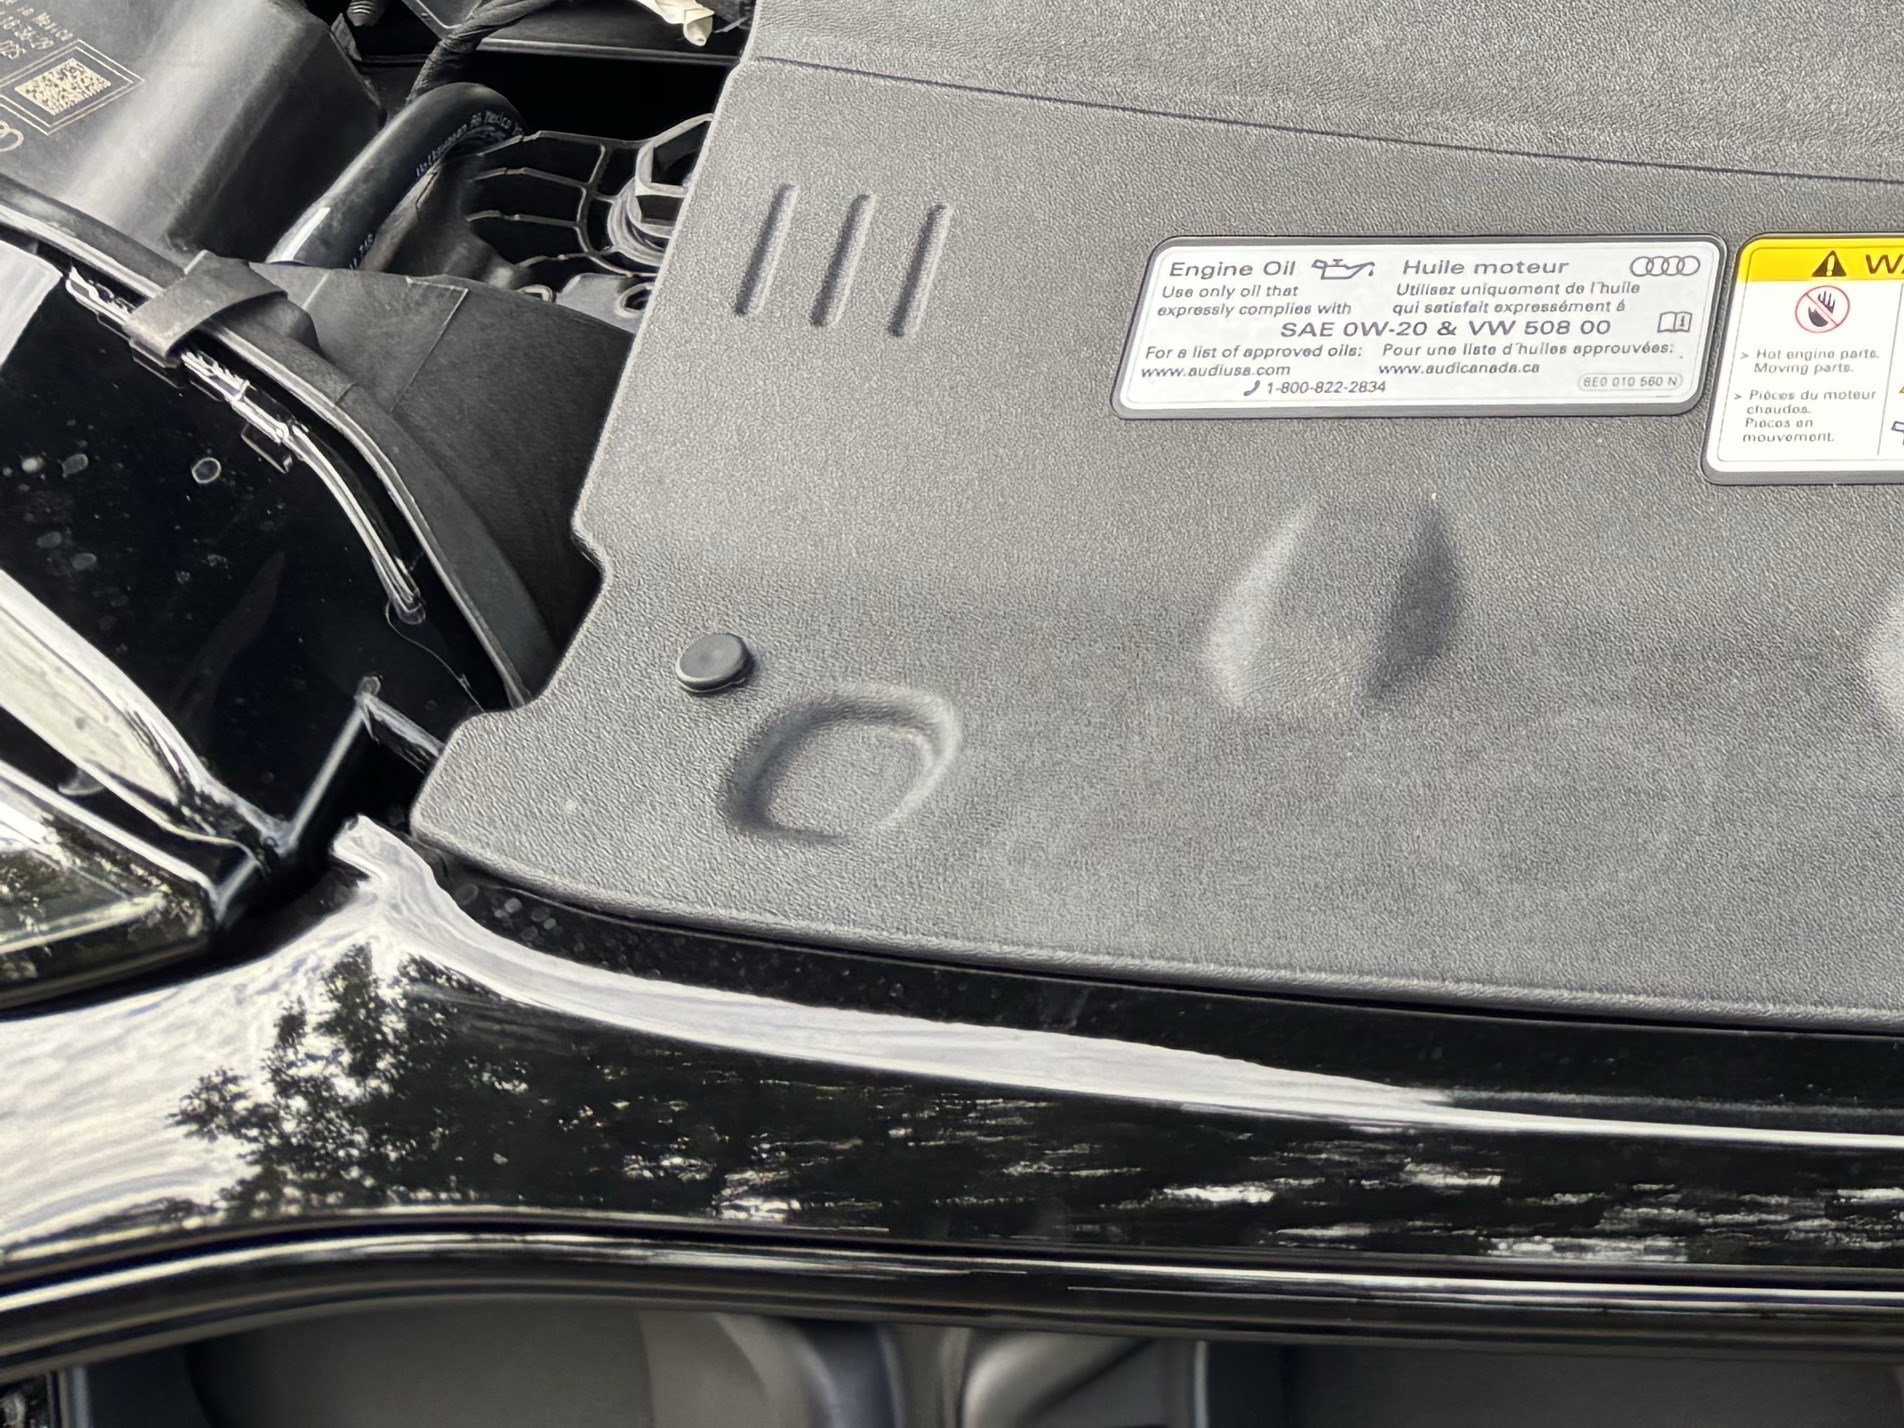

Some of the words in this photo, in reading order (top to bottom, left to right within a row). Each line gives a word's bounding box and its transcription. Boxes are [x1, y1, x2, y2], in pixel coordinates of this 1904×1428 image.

[1169, 261, 1253, 280] Engine
[1263, 260, 1296, 277] Oil
[1403, 259, 1465, 275] Huile
[1473, 260, 1570, 275] moteur
[1162, 285, 1194, 298] Use
[1199, 285, 1237, 300] only
[1240, 285, 1262, 298] oil
[1266, 285, 1299, 297] that
[1396, 282, 1456, 296] Utilisez
[1460, 283, 1560, 298] uniquement
[1565, 282, 1586, 295] de
[1157, 303, 1235, 318] expressly
[1238, 303, 1313, 318] complies
[1317, 302, 1352, 315] with
[1392, 300, 1420, 316] qui
[1424, 300, 1489, 314] satisfait
[1494, 300, 1611, 316] expressément
[1280, 321, 1335, 337] SAE
[1343, 321, 1428, 337] 0W-20
[1436, 321, 1457, 336] &
[1468, 320, 1516, 336] VW
[1523, 320, 1571, 336] 508
[1580, 319, 1612, 335] 00
[1145, 346, 1172, 359] For
[1177, 348, 1188, 359] a
[1192, 344, 1218, 359] list
[1221, 344, 1241, 358] of
[1243, 344, 1323, 360] approved
[1327, 343, 1363, 357] oils:
[1382, 343, 1422, 357] Pour
[1426, 345, 1457, 356] une
[1462, 343, 1497, 356] liste
[1573, 341, 1675, 357] approuvées:
[1756, 348, 1781, 360] Hot
[1786, 348, 1835, 362] engine
[1141, 363, 1292, 378] www.audiusa.com
[1378, 361, 1541, 375] www.audicanada.ca
[1754, 362, 1809, 376] Moving
[1266, 380, 1387, 395] 1-800-822-2834
[1612, 376, 1636, 387] 010
[1668, 375, 1678, 386] N
[1800, 389, 1819, 401] du
[1823, 389, 1877, 400] moteur
